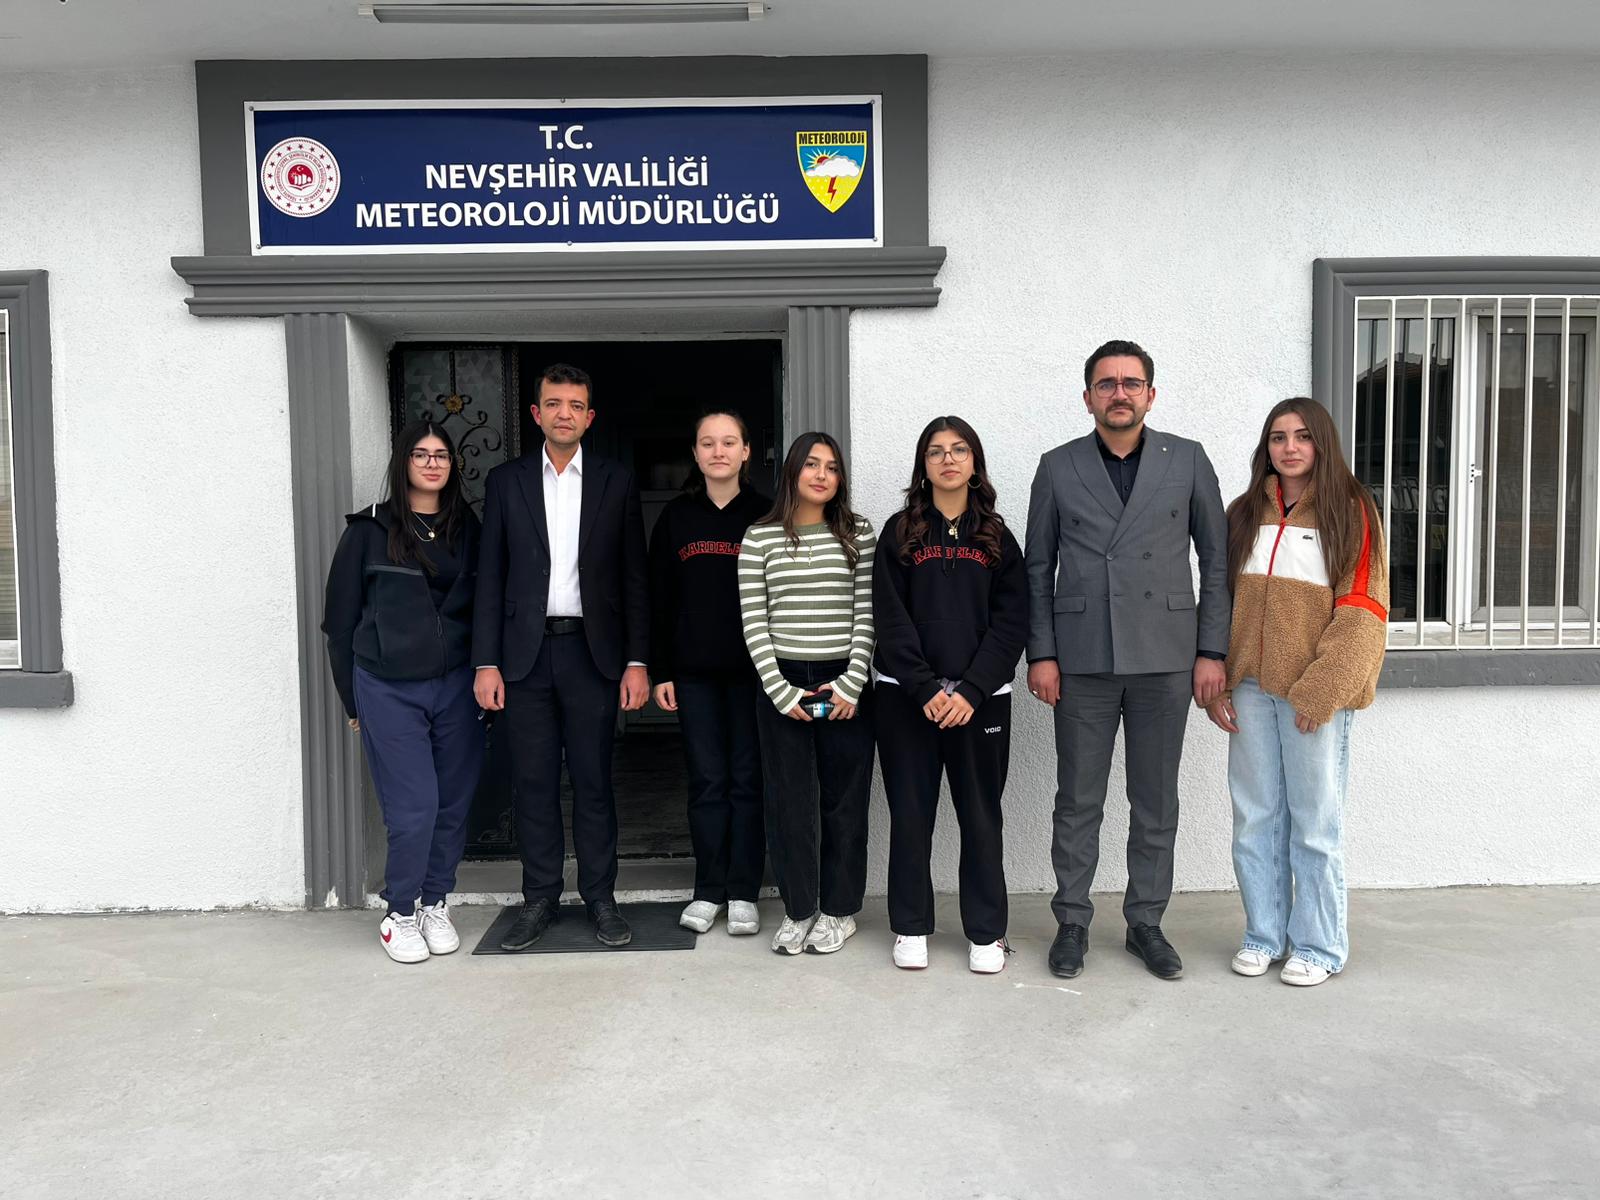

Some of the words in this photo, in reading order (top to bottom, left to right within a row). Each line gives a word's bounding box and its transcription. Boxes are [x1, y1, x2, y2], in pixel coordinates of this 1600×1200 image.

[539, 125, 593, 150] T.C.
[425, 157, 577, 195] NEVŞEHİR
[582, 156, 709, 187] VALİLİĞİ
[356, 195, 570, 228] METEOROLOJİ
[578, 192, 779, 226] MÜDÜRLÜĞÜ
[678, 540, 742, 561] KARDELE
